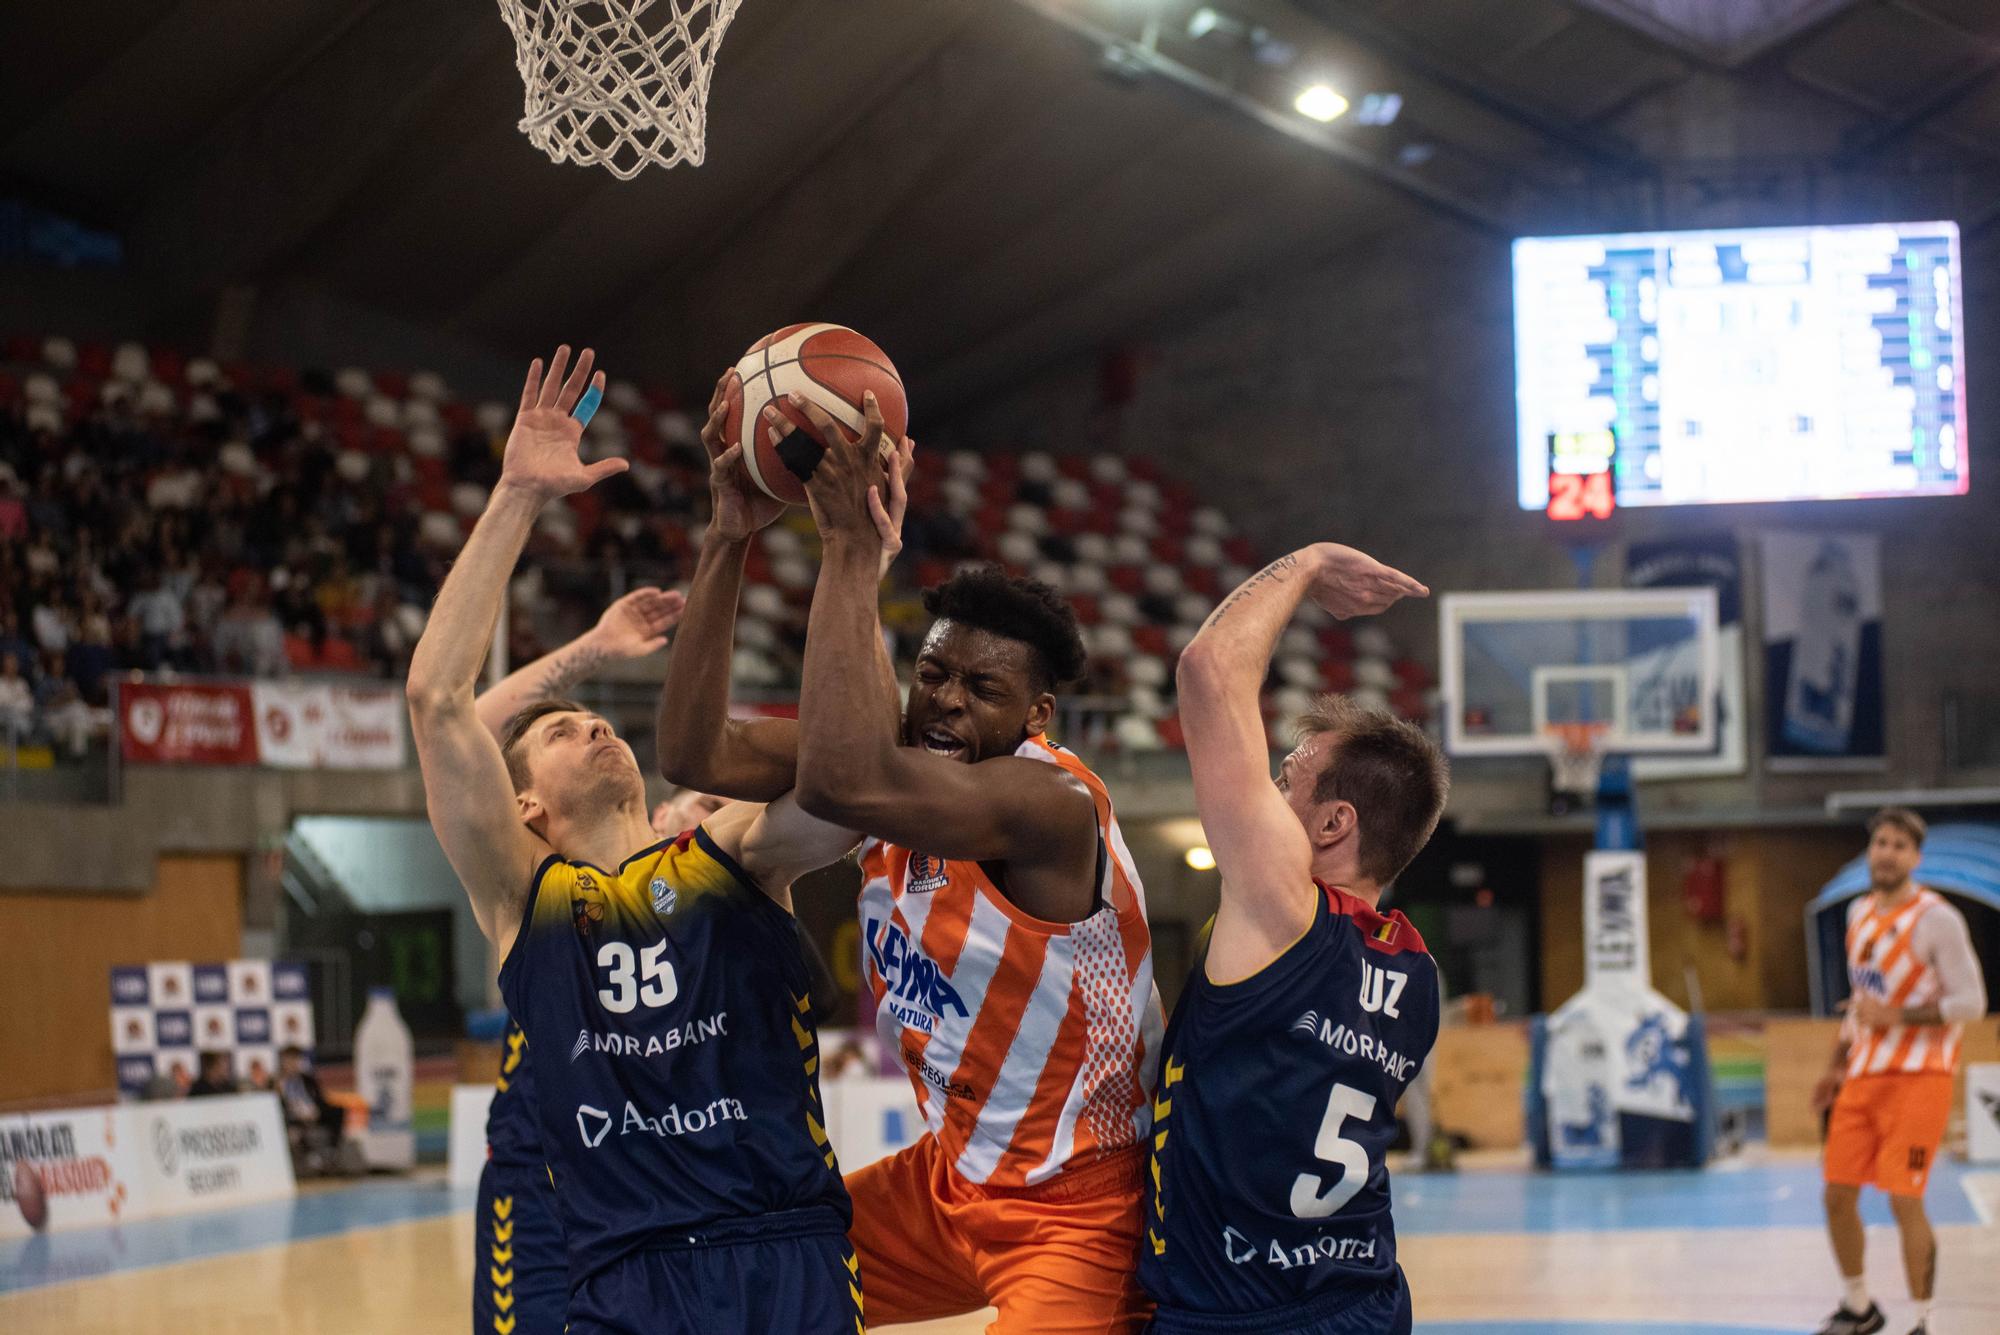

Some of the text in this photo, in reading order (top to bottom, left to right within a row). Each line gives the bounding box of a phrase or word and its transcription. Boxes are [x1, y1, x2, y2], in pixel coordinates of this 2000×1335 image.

[1547, 471, 1616, 521] 24
[597, 938, 678, 1014] 35
[1319, 1018, 1416, 1082] MORANC
[620, 1097, 749, 1137] Andorra
[1289, 1083, 1377, 1218] 5
[1267, 1226, 1376, 1271] Anorra
